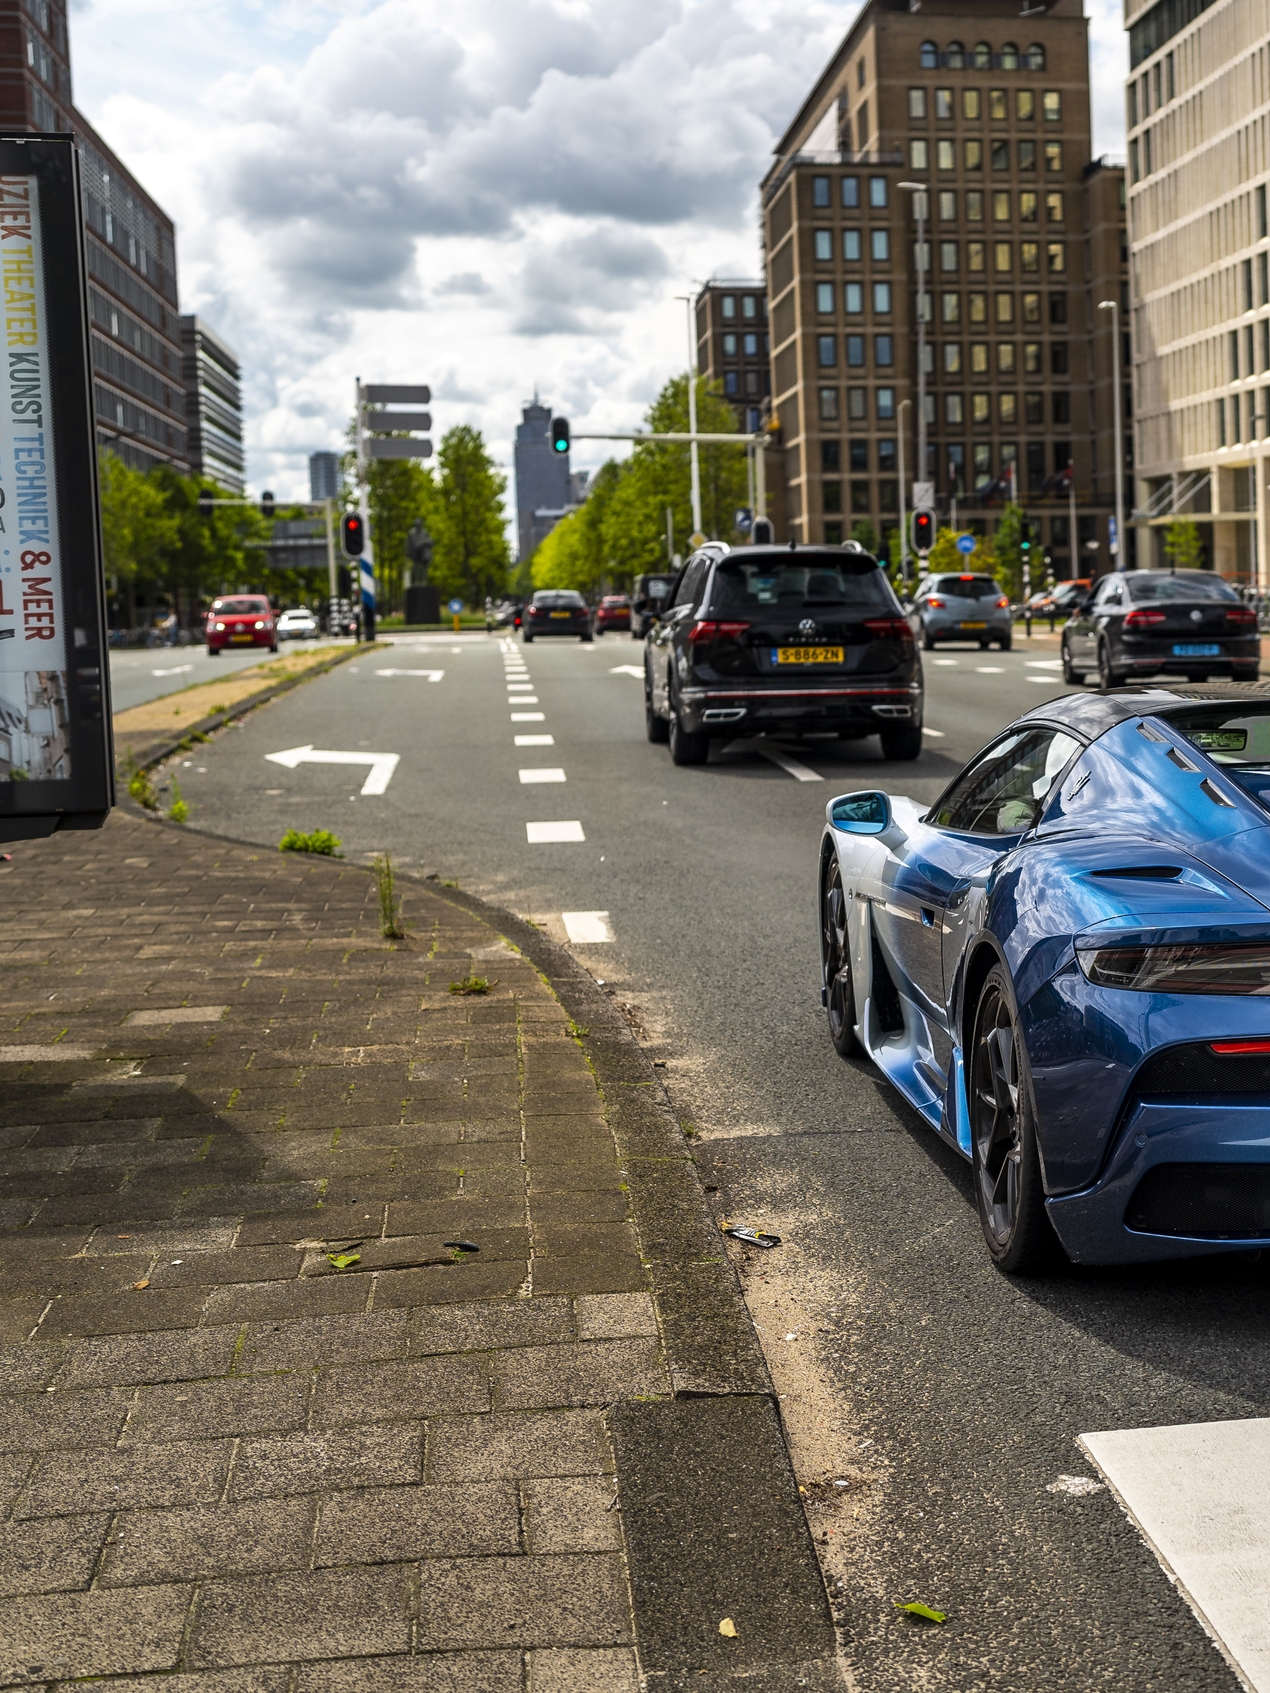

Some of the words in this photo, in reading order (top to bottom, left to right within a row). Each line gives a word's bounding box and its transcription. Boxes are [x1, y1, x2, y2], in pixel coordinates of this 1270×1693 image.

[2, 244, 38, 347] THEATER
[8, 352, 43, 429] KUNST
[13, 432, 50, 545] TECHNIEK
[20, 550, 52, 572] &
[21, 577, 56, 641] MEER
[781, 648, 840, 661] S-886-ZN
